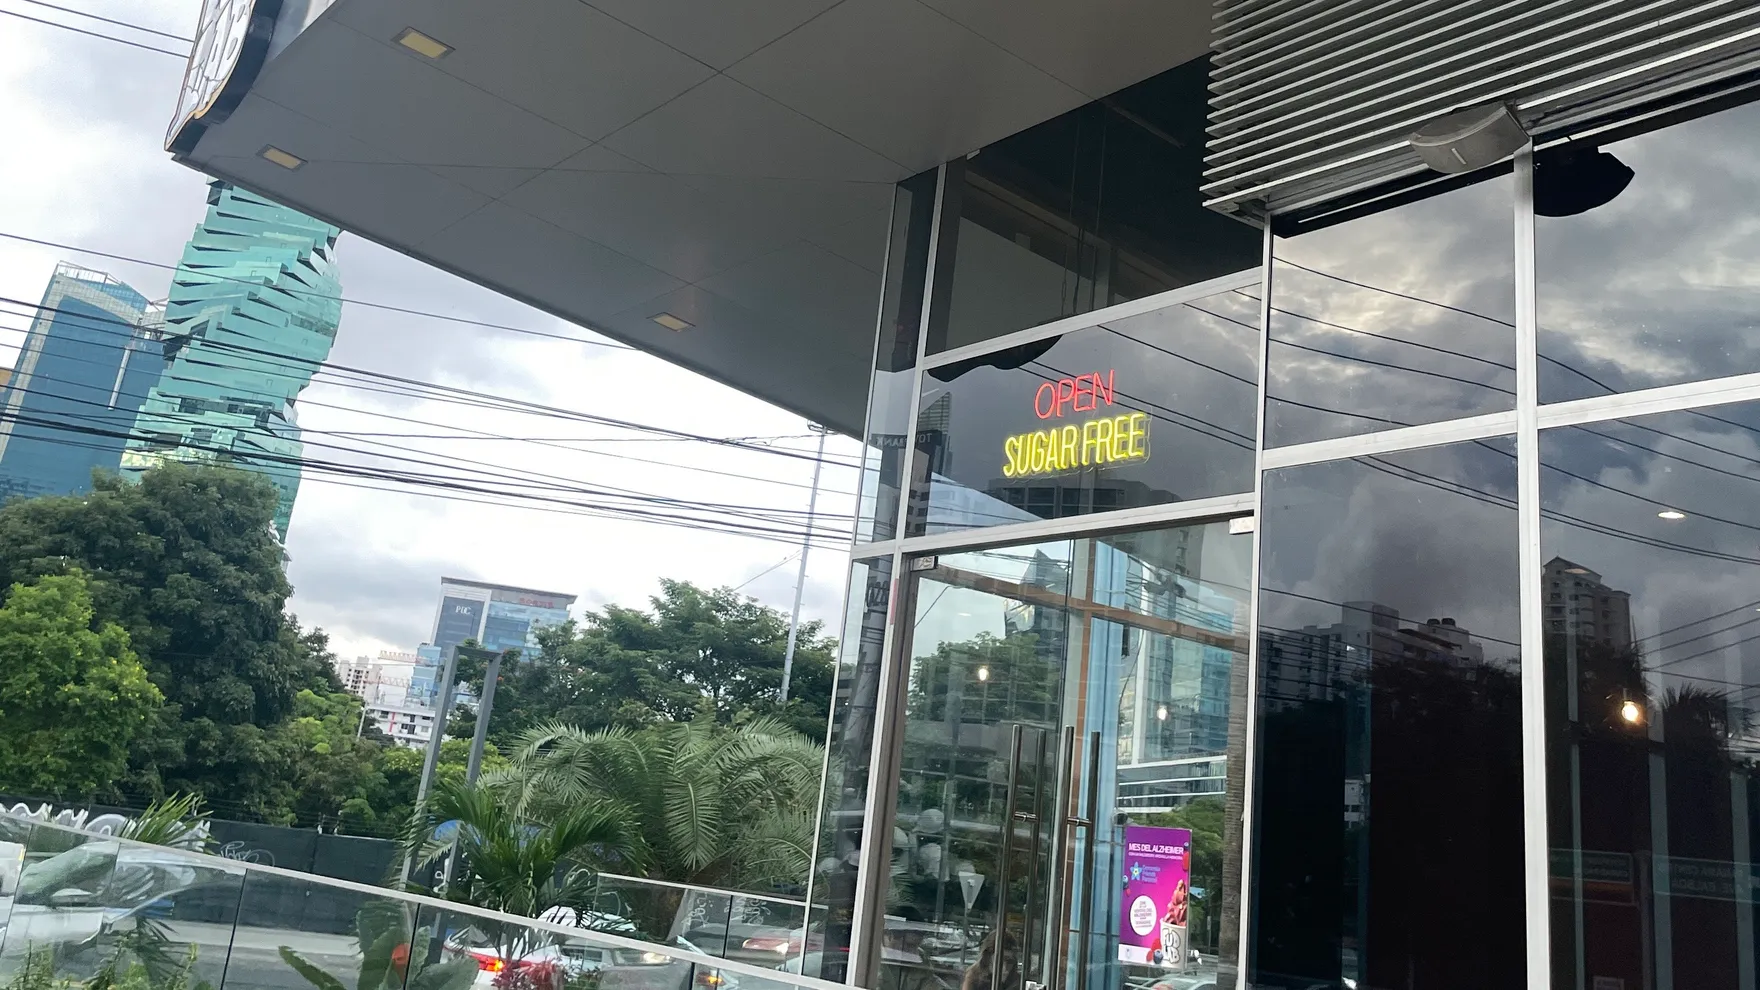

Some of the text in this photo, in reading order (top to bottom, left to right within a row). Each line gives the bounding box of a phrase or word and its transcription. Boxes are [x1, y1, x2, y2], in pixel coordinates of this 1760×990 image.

[1034, 368, 1115, 419] OPEN
[1003, 412, 1146, 478] SUGAR FREE
[1128, 843, 1184, 855] MES DEL ALZHEIMER
